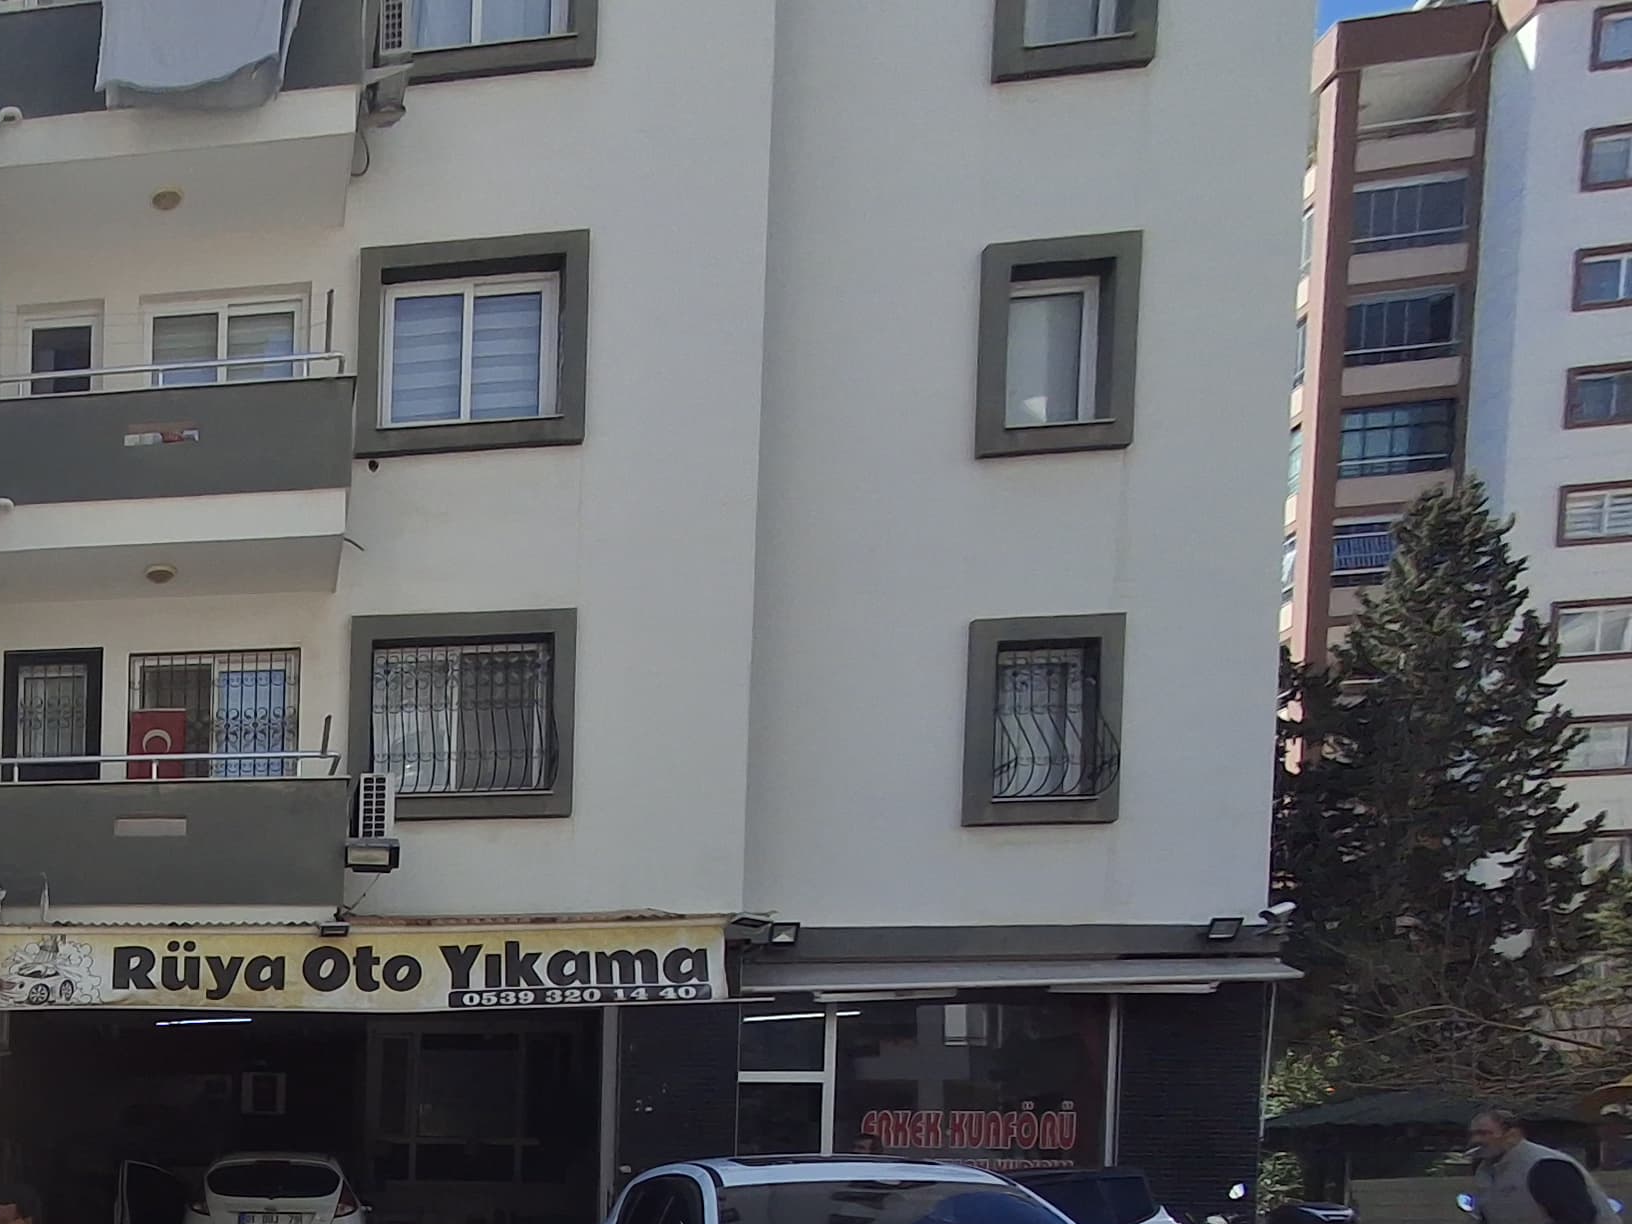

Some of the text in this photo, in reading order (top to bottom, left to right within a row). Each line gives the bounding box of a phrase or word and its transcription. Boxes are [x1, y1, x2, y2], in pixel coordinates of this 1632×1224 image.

[112, 940, 710, 1001] Rüya Oto Yıkama
[462, 986, 697, 1007] 0539 320 14 40
